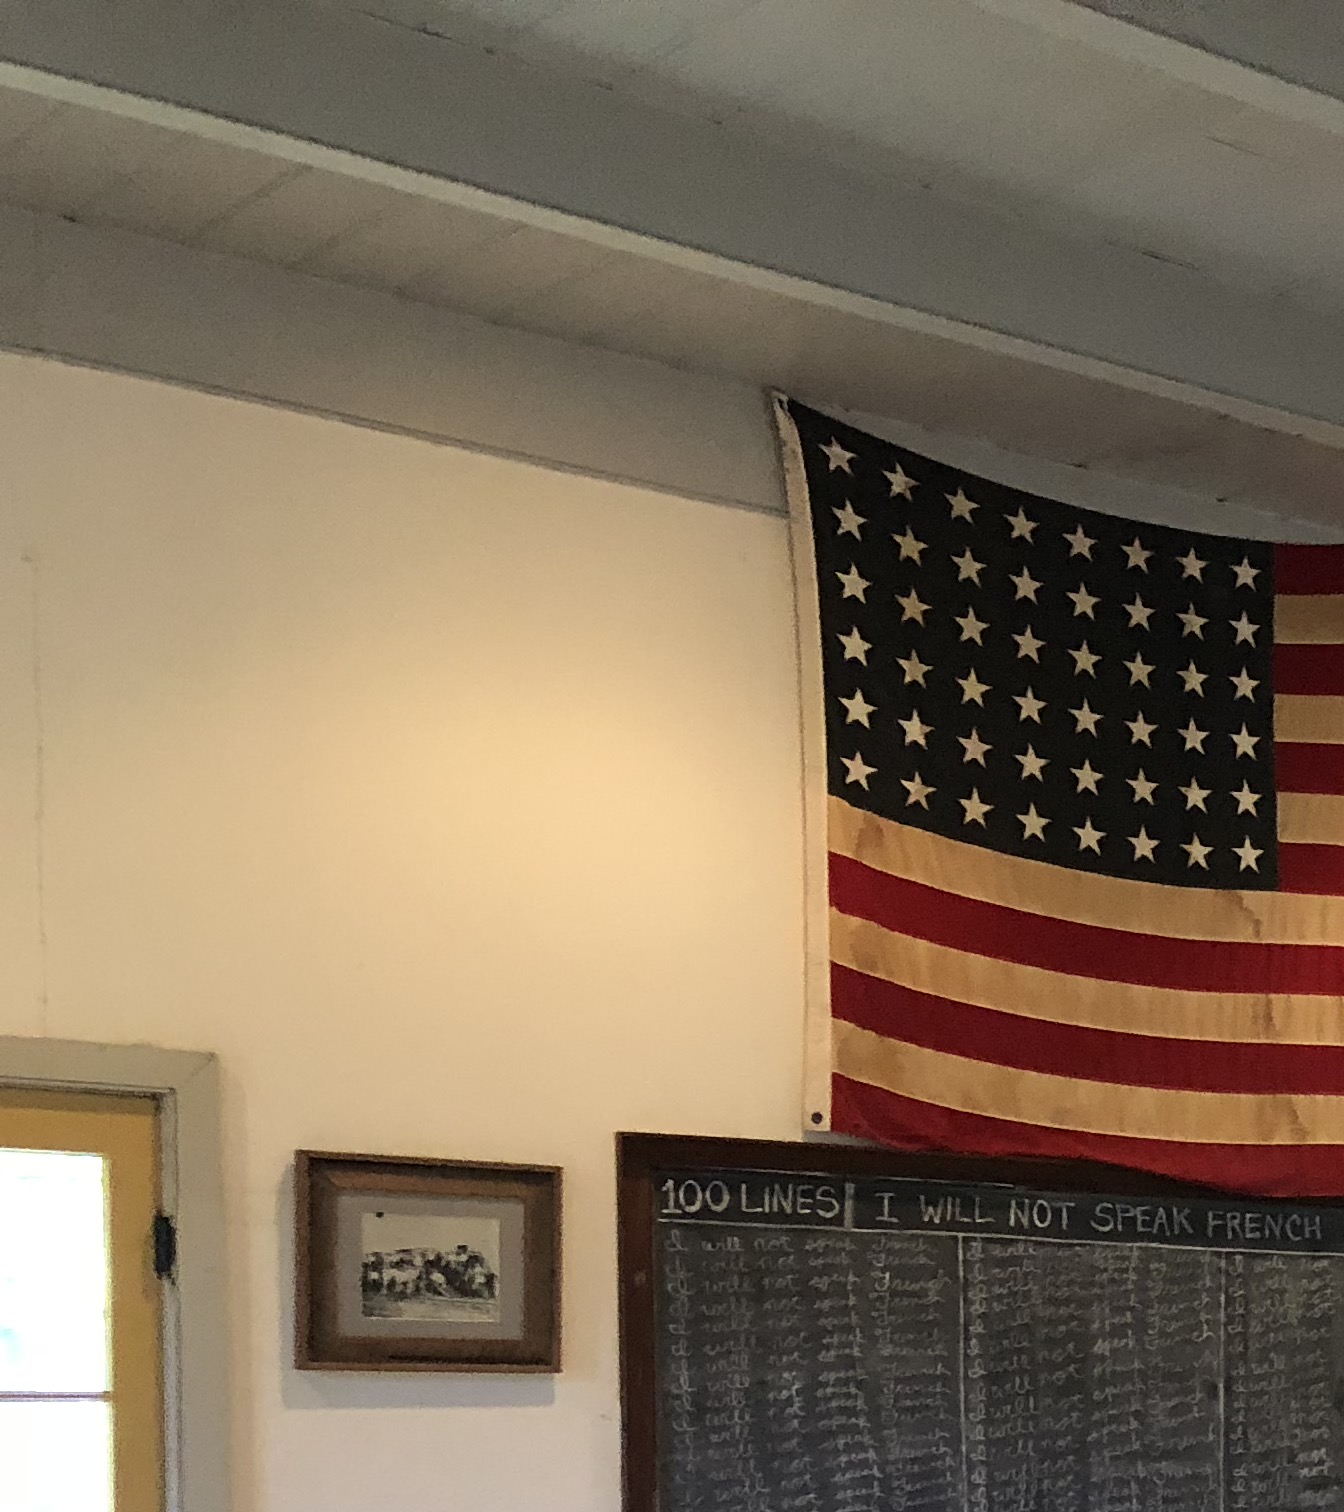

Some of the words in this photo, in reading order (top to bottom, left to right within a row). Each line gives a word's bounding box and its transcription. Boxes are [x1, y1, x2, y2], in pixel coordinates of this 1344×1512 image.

[661, 1178, 730, 1214] 100
[740, 1182, 840, 1219] LINES
[875, 1192, 900, 1223] I
[918, 1194, 995, 1225] WILL
[1008, 1199, 1076, 1230] NOT
[1089, 1203, 1194, 1235] SPEAK
[1206, 1210, 1323, 1243] FRENCH
